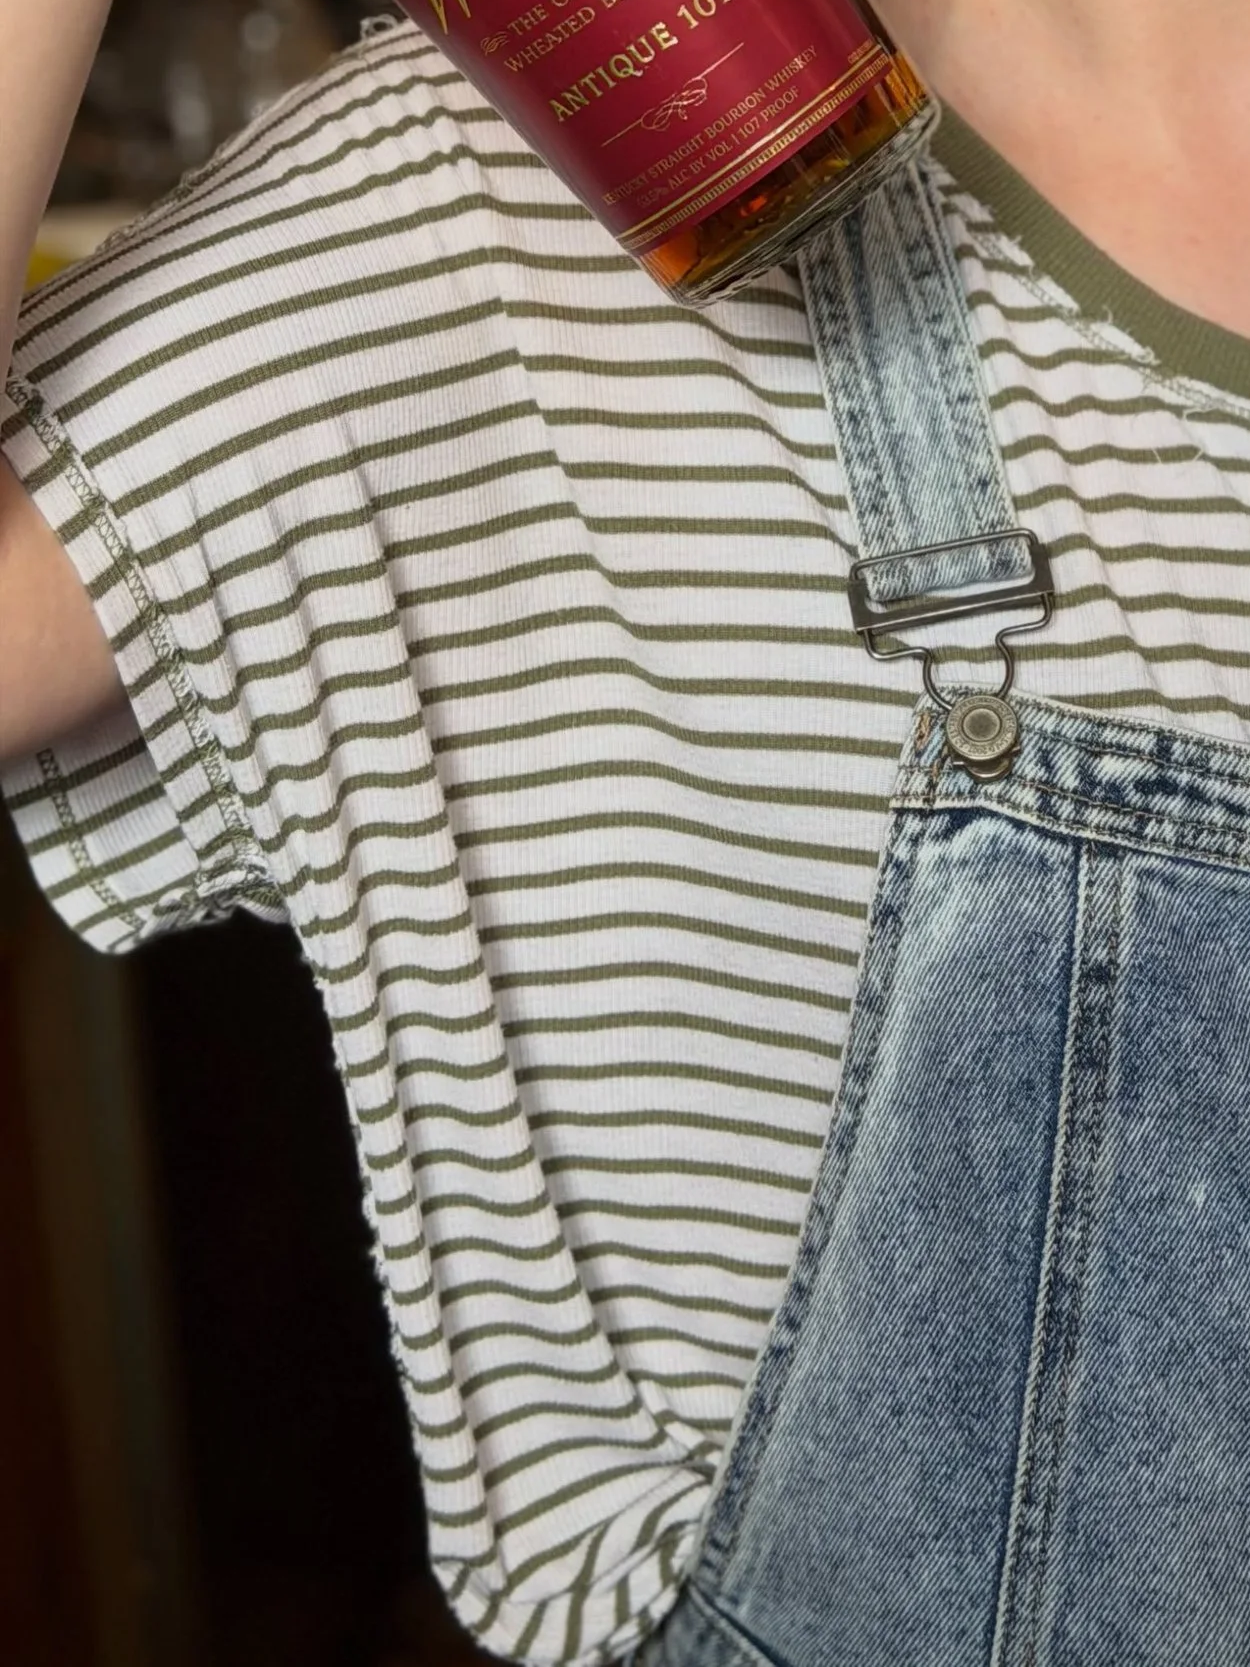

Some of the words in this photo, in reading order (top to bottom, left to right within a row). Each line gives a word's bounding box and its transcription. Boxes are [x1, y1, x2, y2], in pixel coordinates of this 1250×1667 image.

[503, 5, 597, 73] WHEATED
[507, 3, 550, 37] THE
[549, 21, 679, 123] ANTIQUE
[647, 134, 705, 179] STRAIGHT
[703, 87, 767, 140] BOURBON
[764, 45, 818, 93] WHISKEY
[668, 168, 690, 191] ALC
[689, 156, 707, 176] BY
[707, 139, 734, 163] VOL
[737, 117, 761, 139] 107
[759, 85, 800, 122] PROOF
